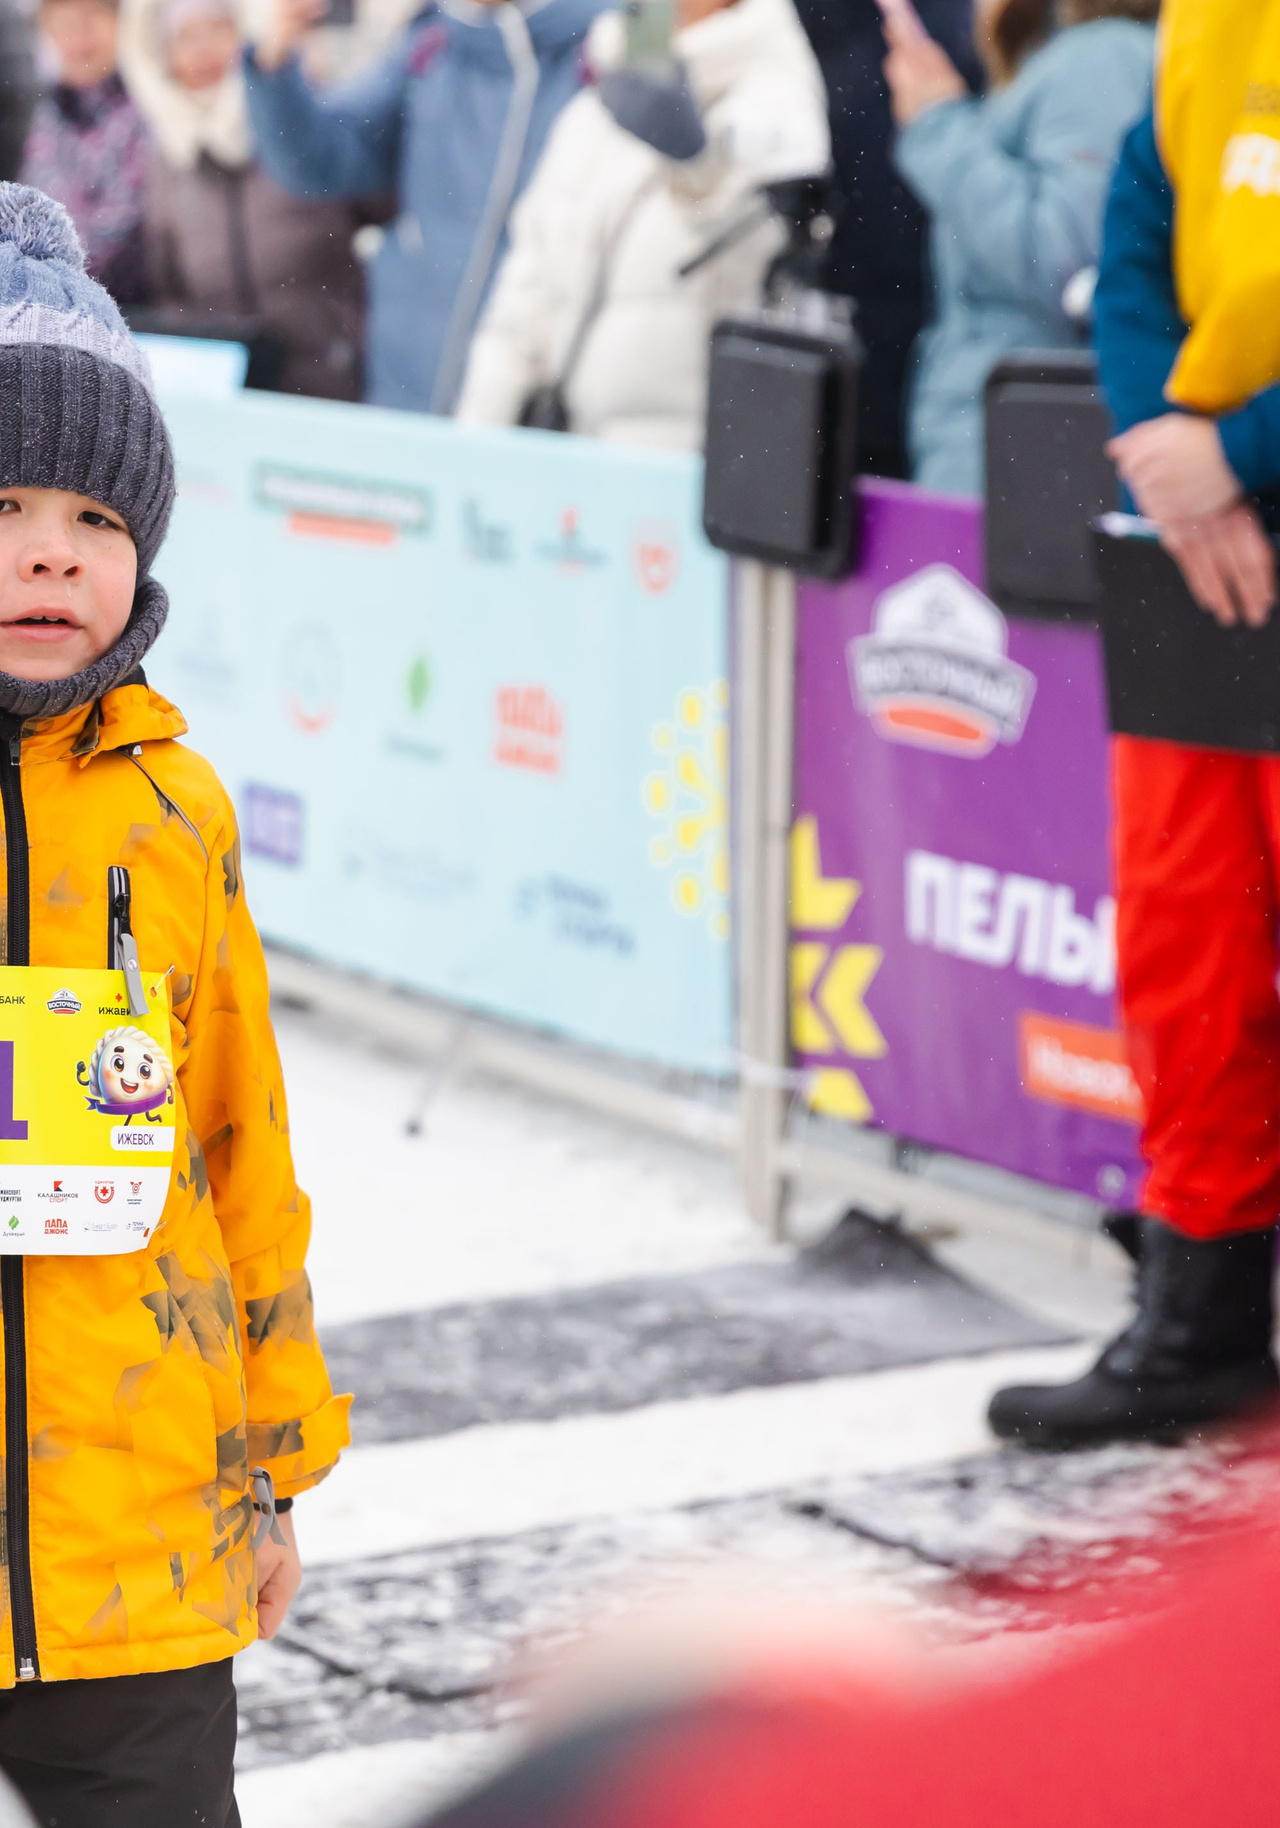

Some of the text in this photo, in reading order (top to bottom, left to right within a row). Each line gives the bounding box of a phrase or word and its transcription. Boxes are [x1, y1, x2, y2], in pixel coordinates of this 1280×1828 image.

[905, 849, 1117, 996] ПЕЛЬ
[47, 1000, 81, 1011] ВОСТОЧНЫЙ
[98, 1006, 131, 1016] ижави
[117, 1132, 155, 1146] ИЖЕВСК
[44, 1218, 68, 1228] ПАПА
